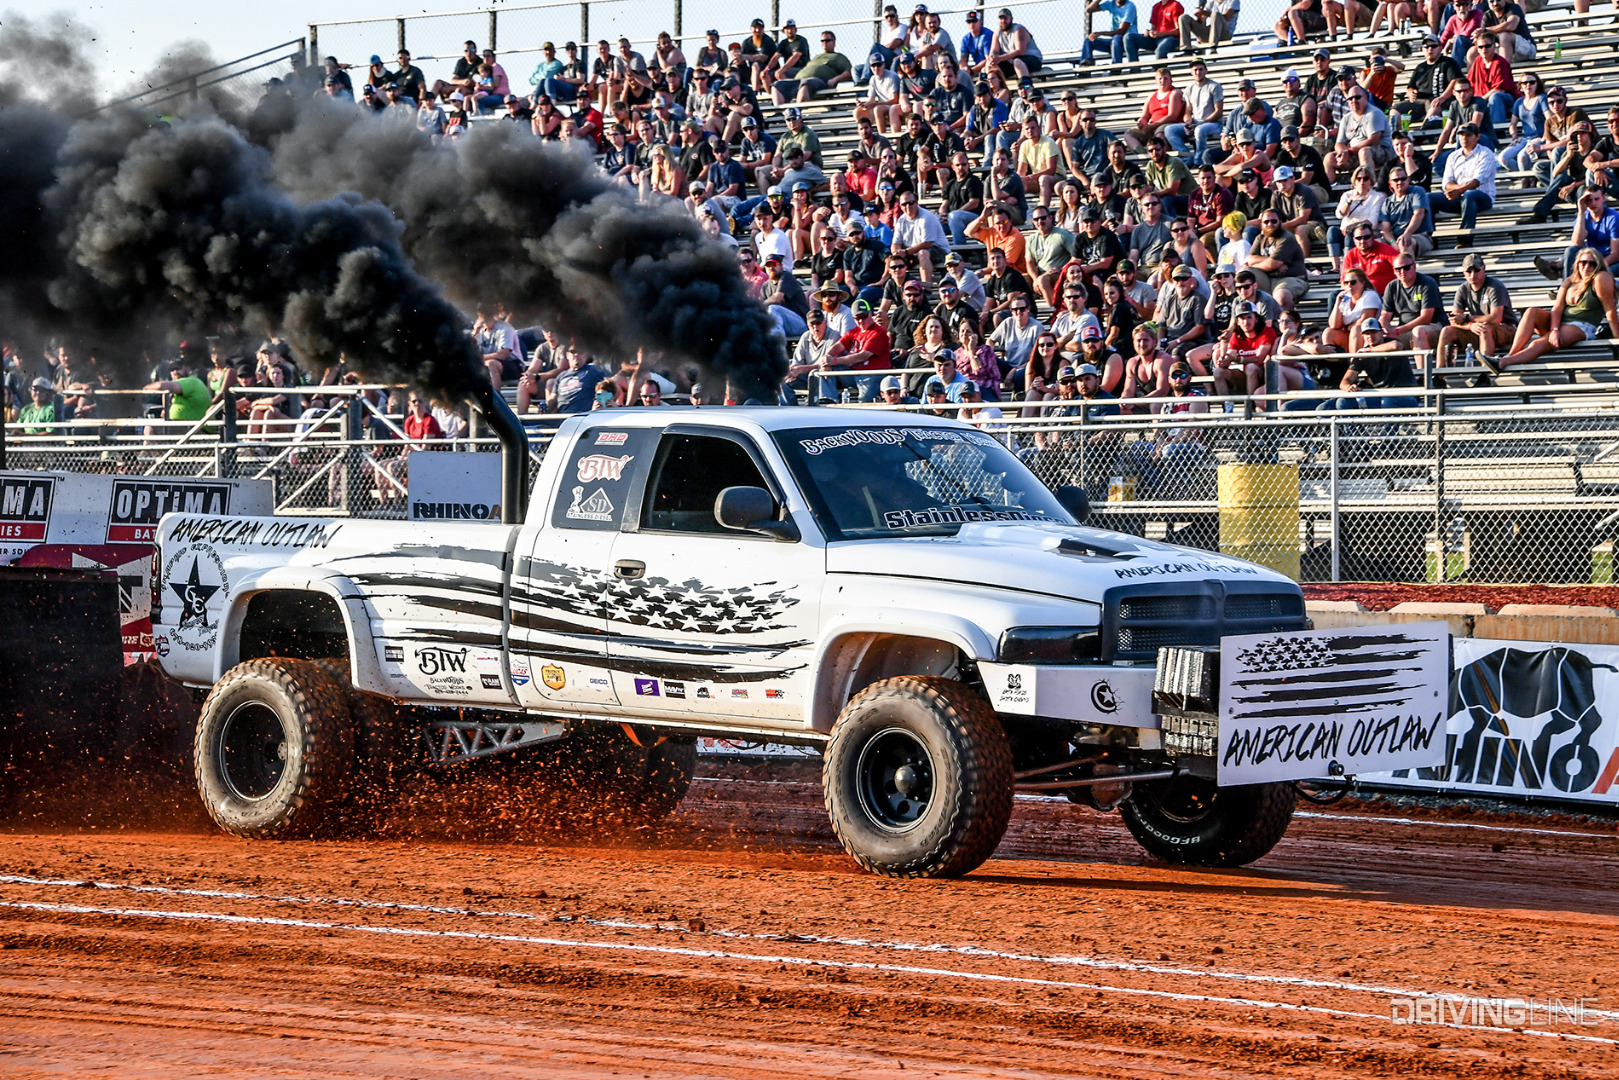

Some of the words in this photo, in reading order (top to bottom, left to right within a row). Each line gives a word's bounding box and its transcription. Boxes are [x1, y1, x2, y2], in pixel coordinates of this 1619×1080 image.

[800, 428, 903, 455] BACKWOODS
[116, 489, 221, 519] OPTIMA
[587, 498, 607, 512] SD
[169, 518, 263, 545] AMERICAN
[261, 521, 343, 548] OUTLAW
[1114, 563, 1197, 579] AMERICAN
[416, 647, 469, 675] BTW
[1223, 721, 1343, 768] AMERICAN
[1347, 712, 1442, 757] OUTLAW
[1391, 734, 1619, 794] HINO
